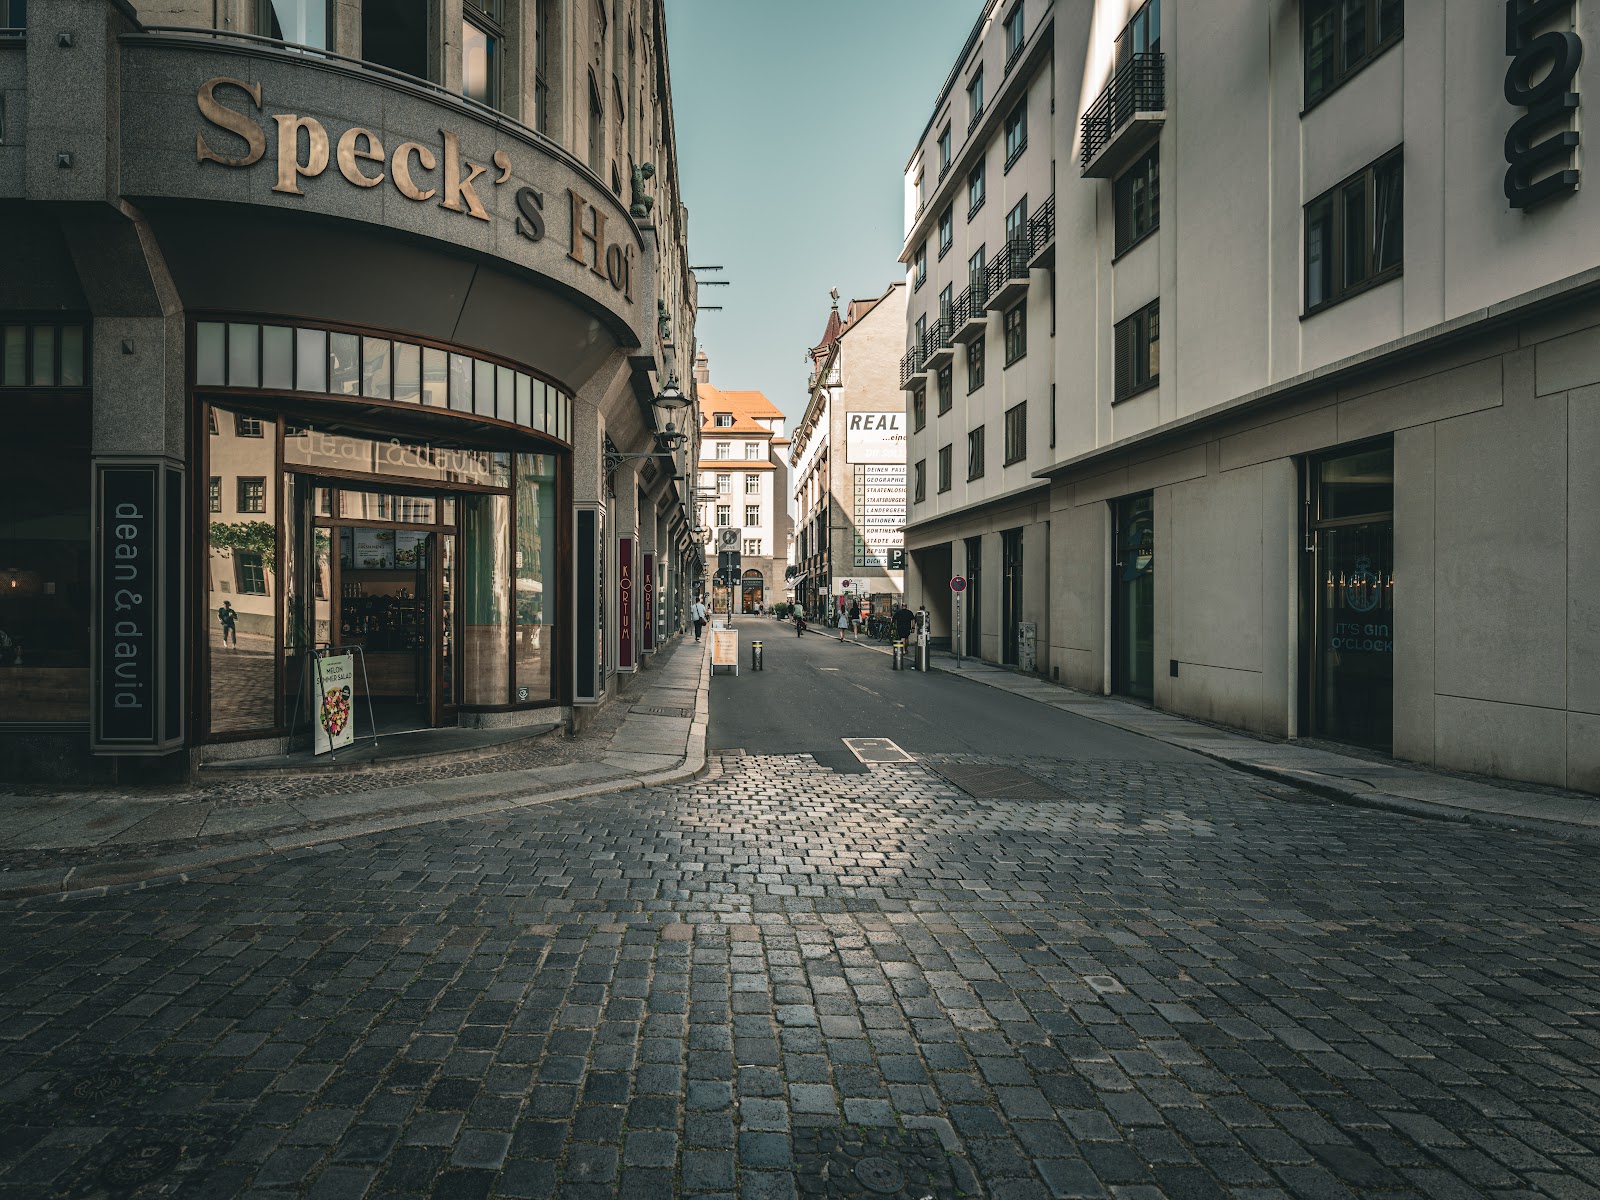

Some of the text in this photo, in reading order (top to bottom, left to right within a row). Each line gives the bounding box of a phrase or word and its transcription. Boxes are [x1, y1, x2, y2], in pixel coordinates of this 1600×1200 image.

[197, 77, 635, 304] Speck's Hof
[850, 414, 899, 430] REAL
[893, 550, 902, 561] P
[620, 566, 631, 640] KORTUM
[644, 575, 652, 630] KORTUM
[1332, 637, 1392, 652] O'CLOCK
[317, 672, 352, 684] SMMER SALAD
[326, 666, 343, 675] MELON
